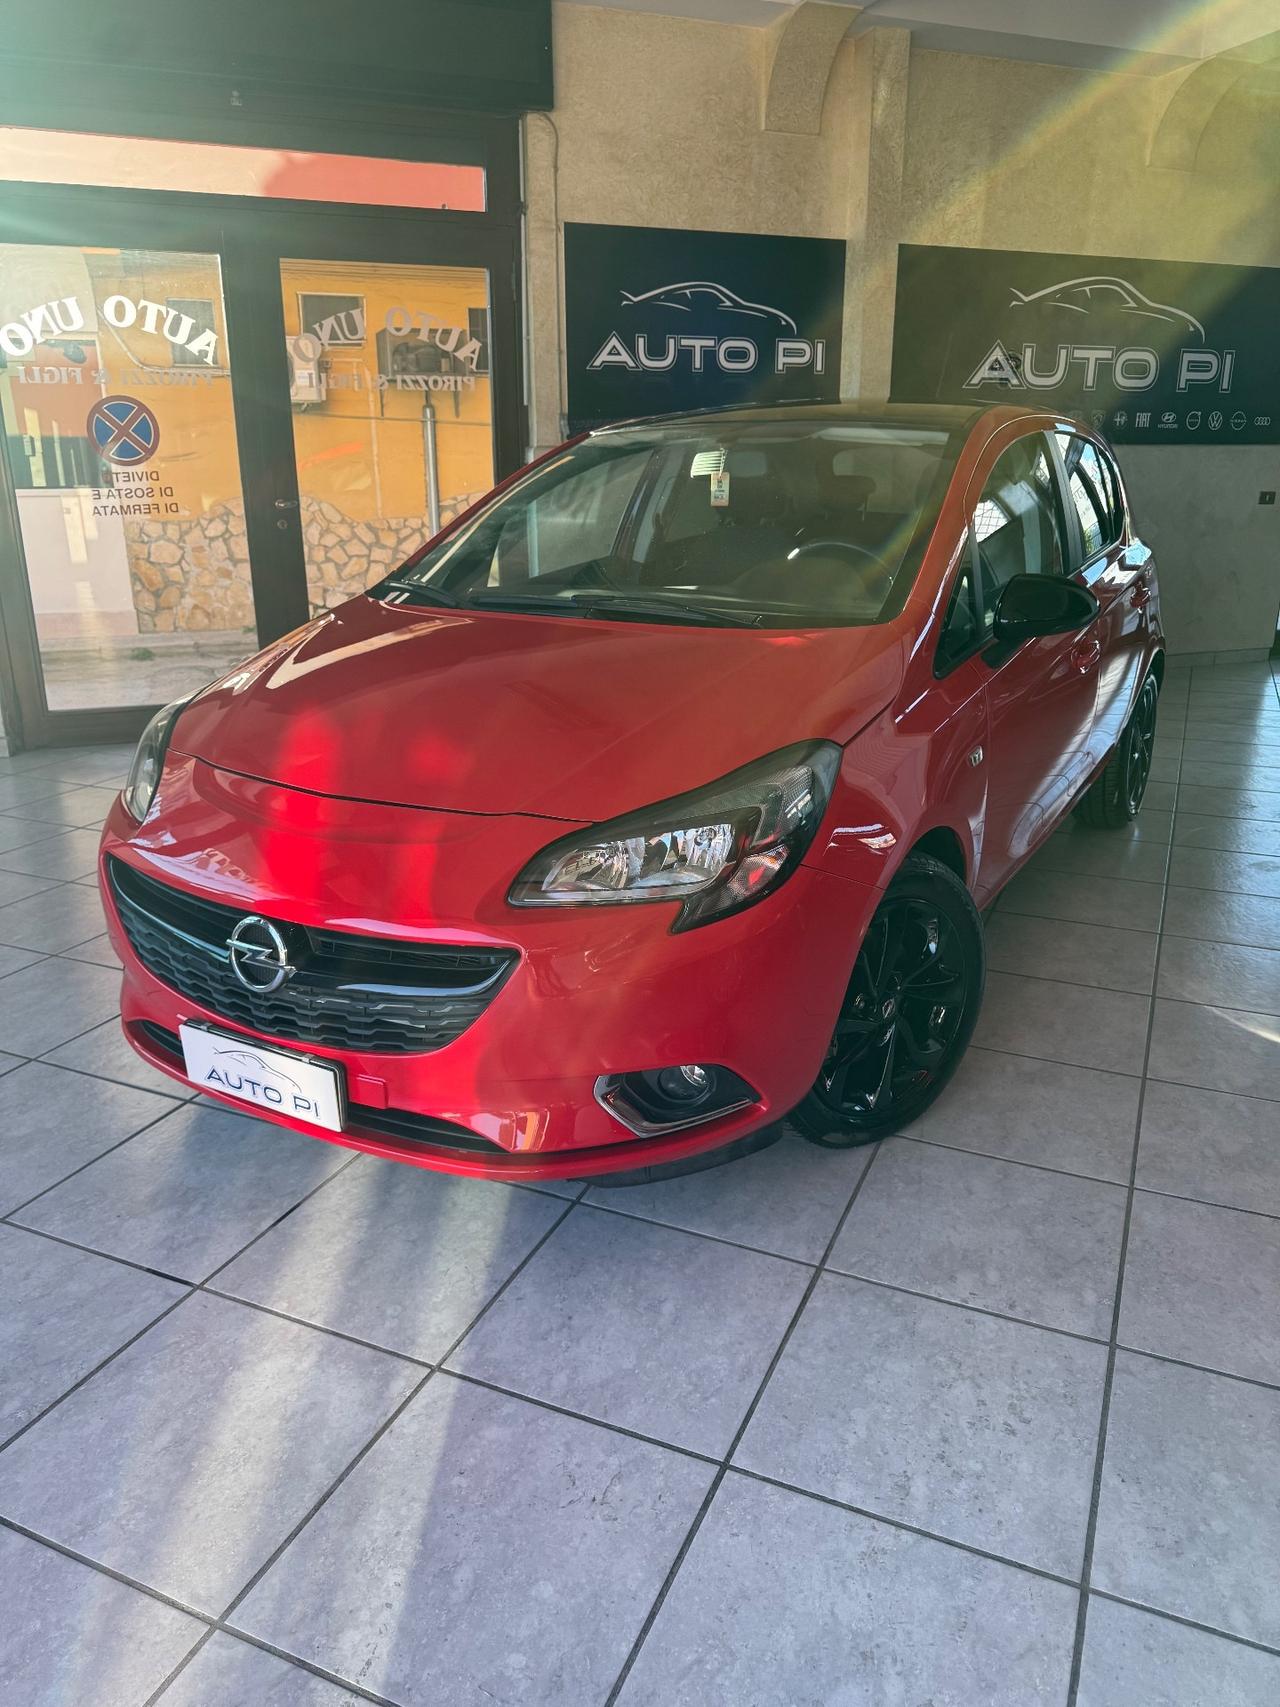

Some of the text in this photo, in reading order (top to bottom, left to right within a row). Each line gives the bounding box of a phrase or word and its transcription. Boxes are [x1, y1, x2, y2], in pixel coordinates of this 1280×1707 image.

[586, 331, 825, 374] AUTO PI
[962, 339, 1236, 393] AUTO PI
[1136, 412, 1151, 428] FIAT
[206, 1066, 321, 1119] AUTO PI
